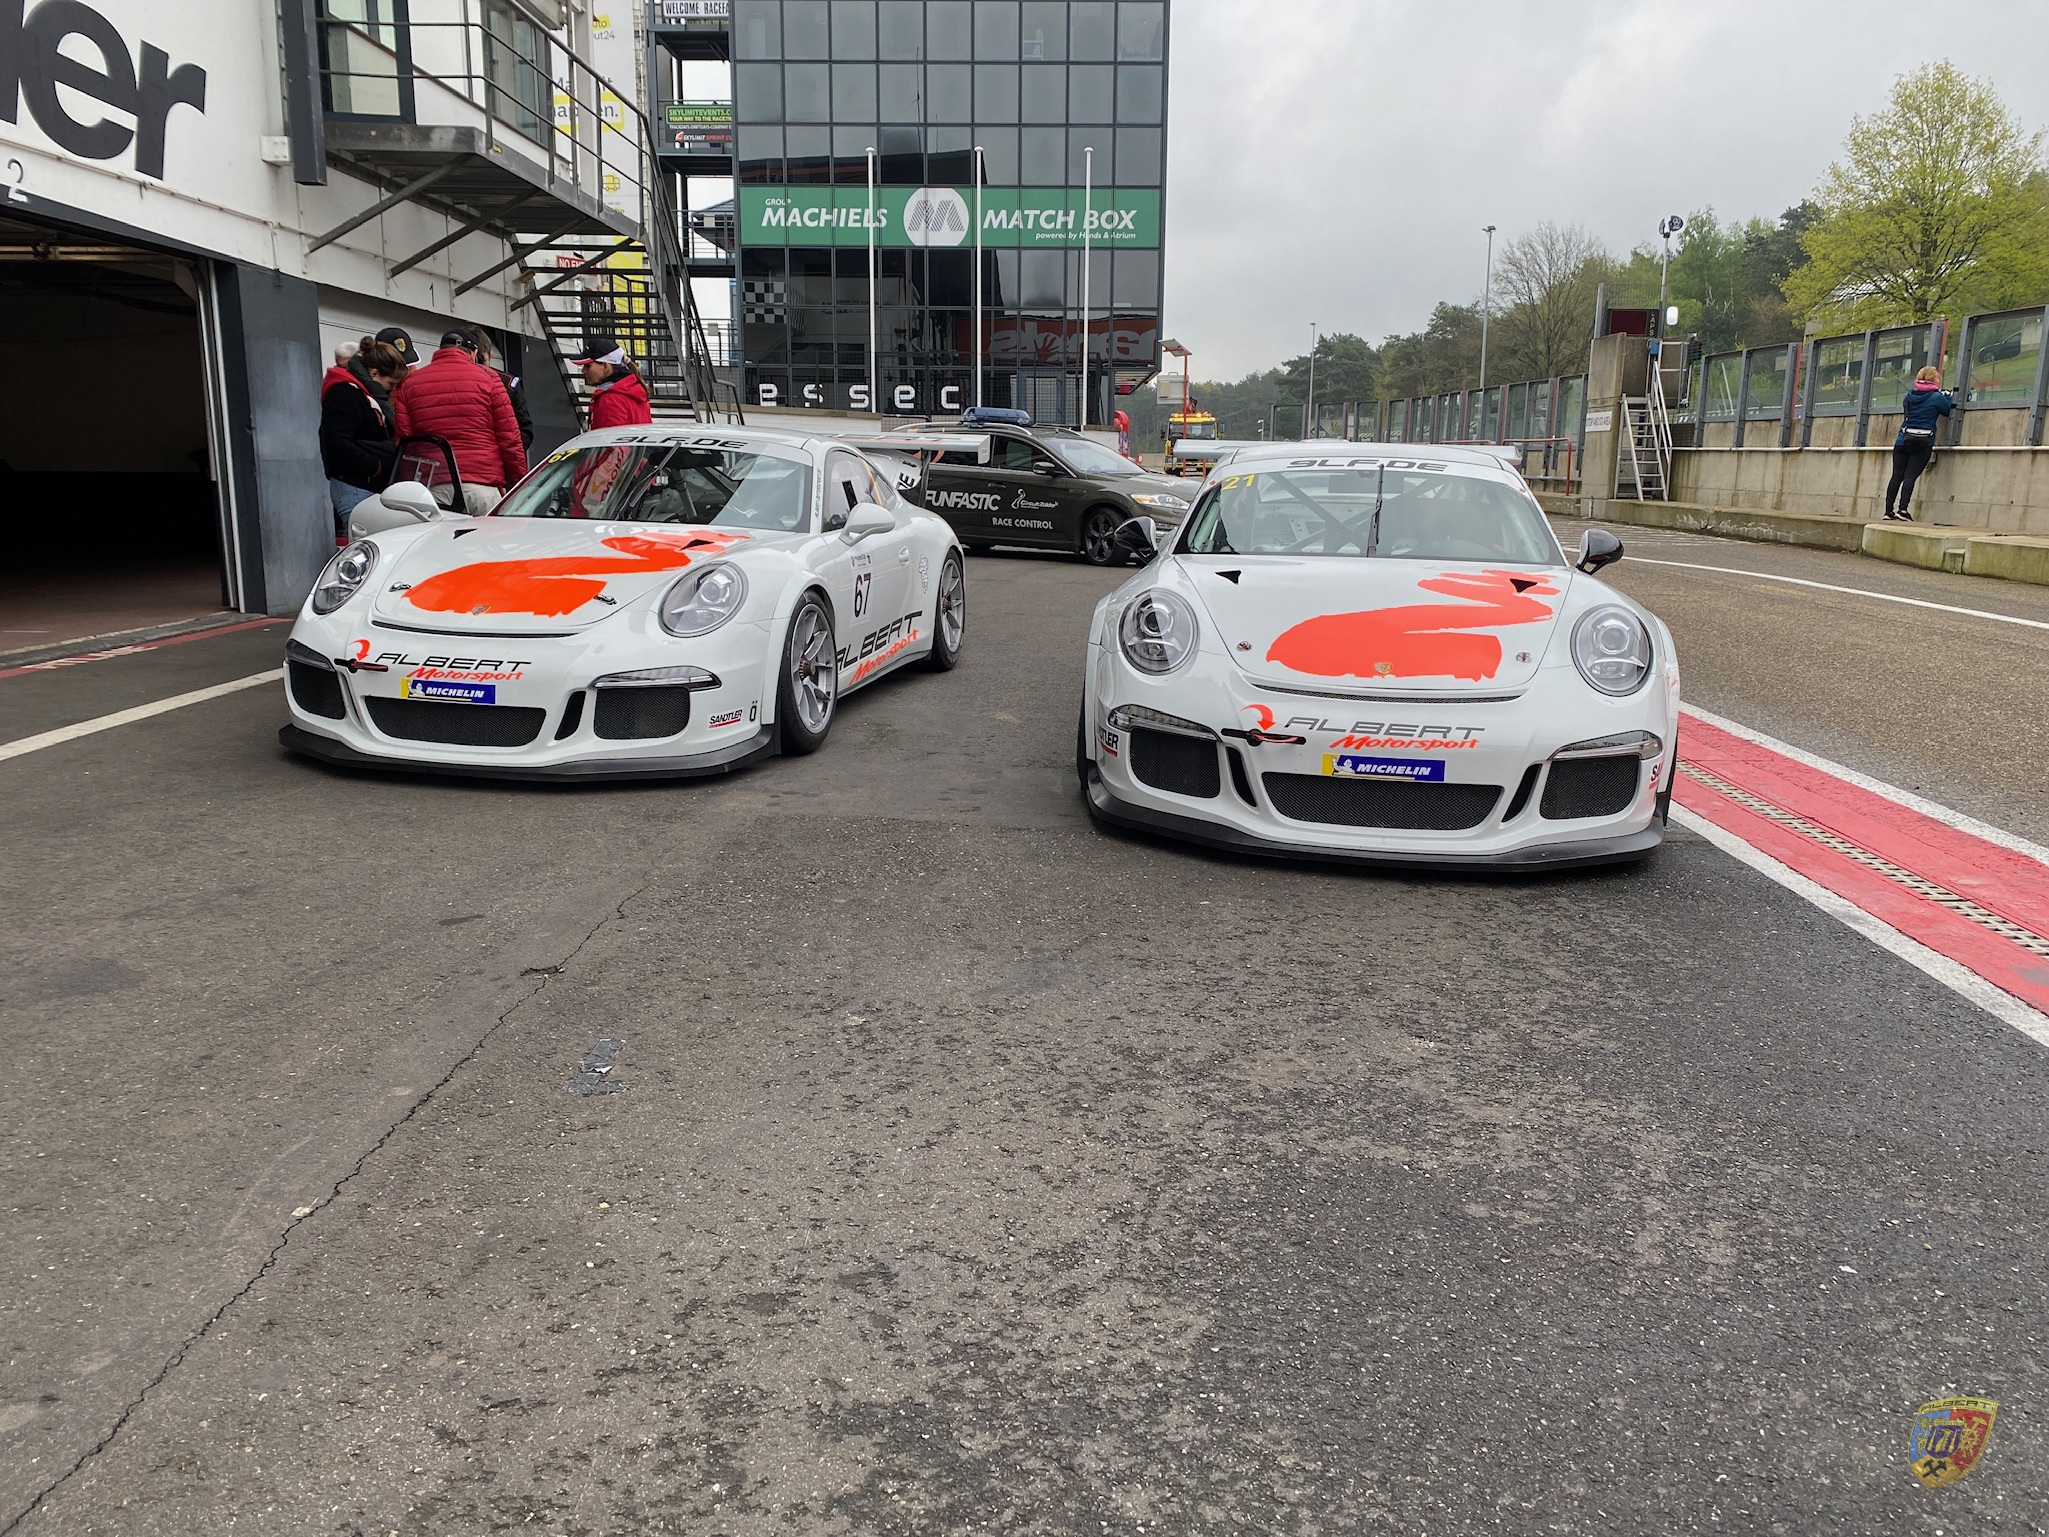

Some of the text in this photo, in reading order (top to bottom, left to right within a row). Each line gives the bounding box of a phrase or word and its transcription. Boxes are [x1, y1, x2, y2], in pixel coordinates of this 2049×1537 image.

[665, 2, 699, 14] WELCOME
[761, 207, 888, 228] MACHIELS
[983, 209, 1138, 230] MATCH BOX
[1068, 231, 1077, 240] by
[548, 448, 580, 464] 67
[1221, 474, 1255, 491] 21
[925, 489, 1001, 512] FUNFASTIC
[992, 517, 1054, 530] RACE CONTROL
[854, 573, 871, 618] 67
[375, 652, 532, 672] ALBERT
[848, 629, 919, 688] Motorsport
[406, 666, 525, 683] Motorsport
[425, 686, 485, 699] MICHELIN
[709, 709, 743, 725] SANDTLER
[1284, 716, 1486, 740] ALBERT
[1329, 734, 1481, 751] Motorsport
[1356, 763, 1431, 776] MICHELIN
